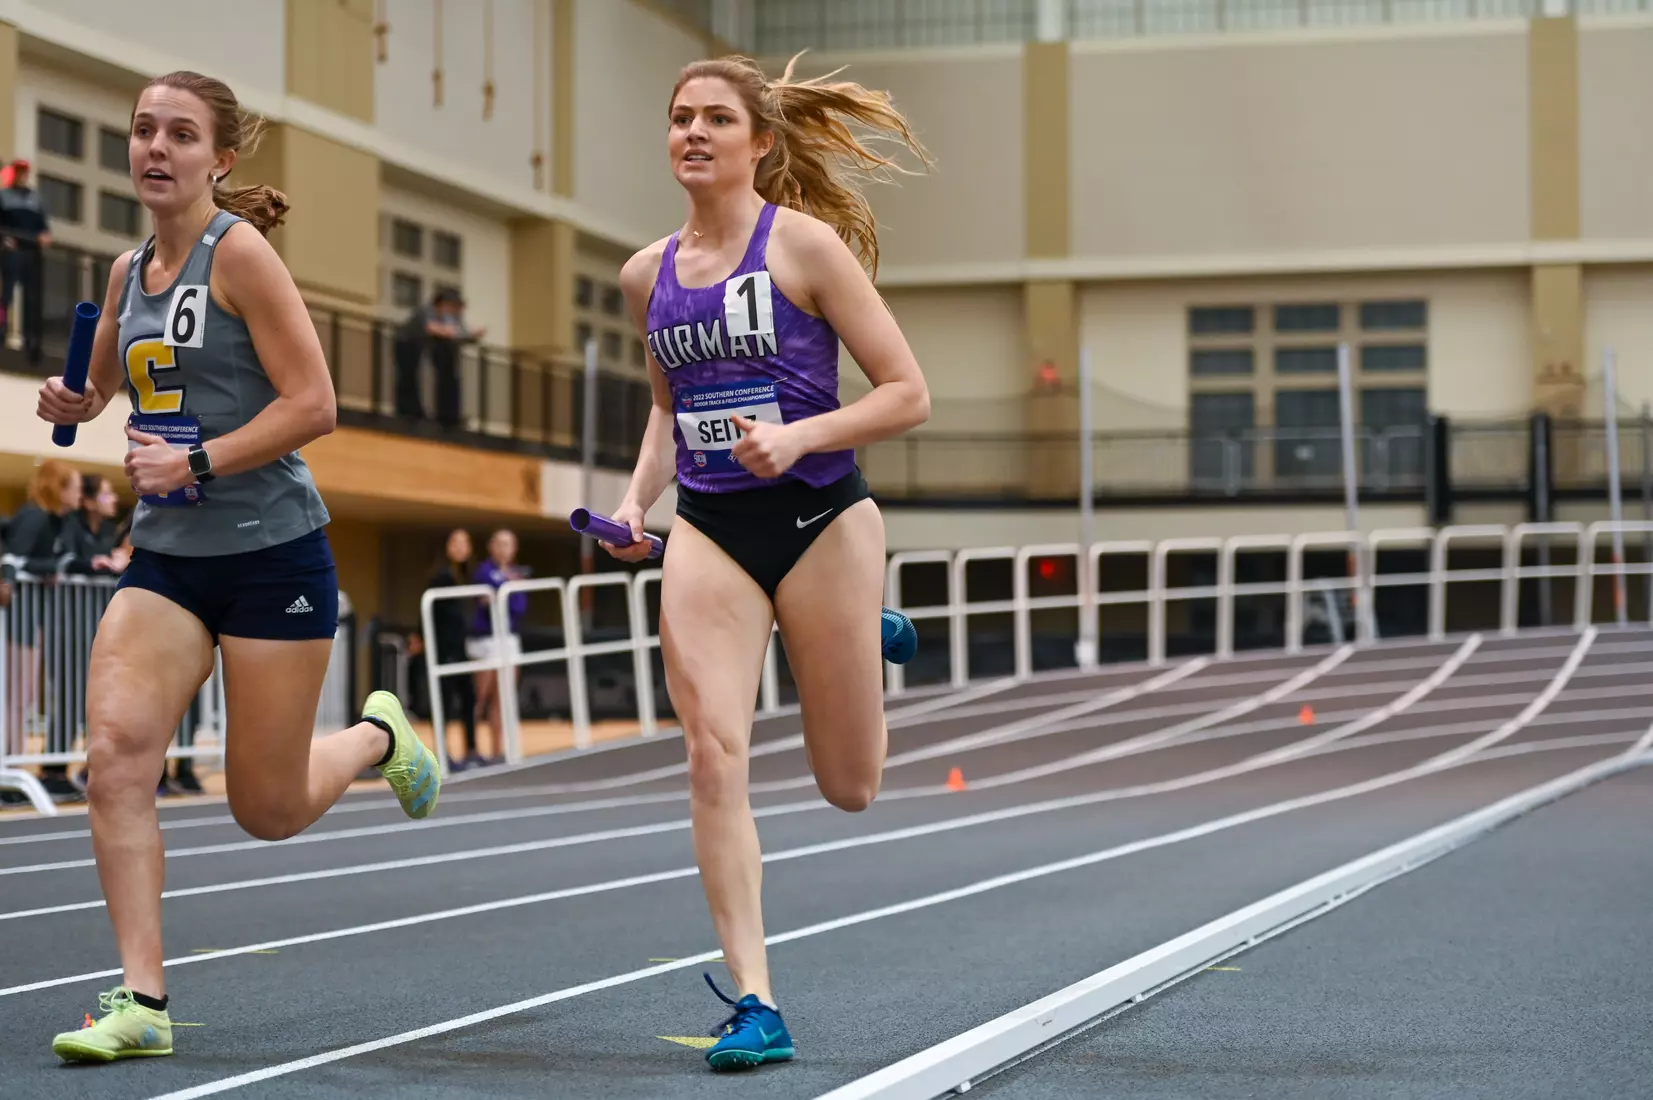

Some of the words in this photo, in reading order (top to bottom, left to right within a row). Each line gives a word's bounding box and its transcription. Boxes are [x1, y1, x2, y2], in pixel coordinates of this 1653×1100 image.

[736, 276, 759, 331] 1
[171, 288, 198, 344] 6
[125, 335, 185, 415] C
[705, 390, 734, 400] SOUTHERN
[734, 385, 775, 396] CONFERENCE
[737, 392, 775, 402] CHAMPIONSHIPS
[168, 425, 199, 433] CONFERENCE
[697, 414, 756, 444] SEIT
[285, 605, 314, 613] adidas
